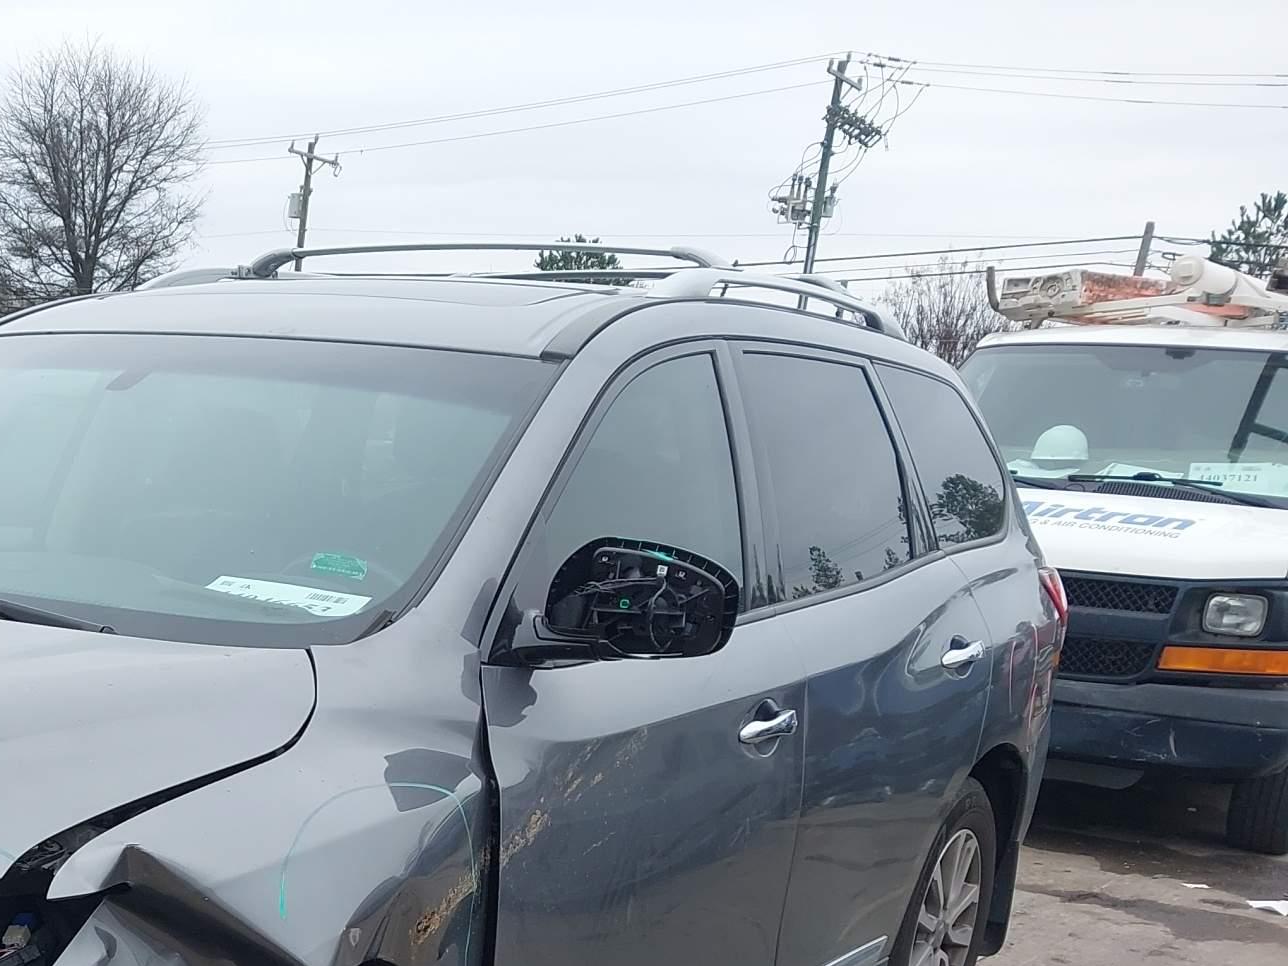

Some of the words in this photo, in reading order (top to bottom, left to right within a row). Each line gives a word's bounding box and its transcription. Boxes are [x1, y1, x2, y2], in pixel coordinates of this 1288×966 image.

[1023, 501, 1197, 530] Airtron
[1052, 520, 1078, 528] AIR
[1079, 523, 1181, 539] CONDITIONING
